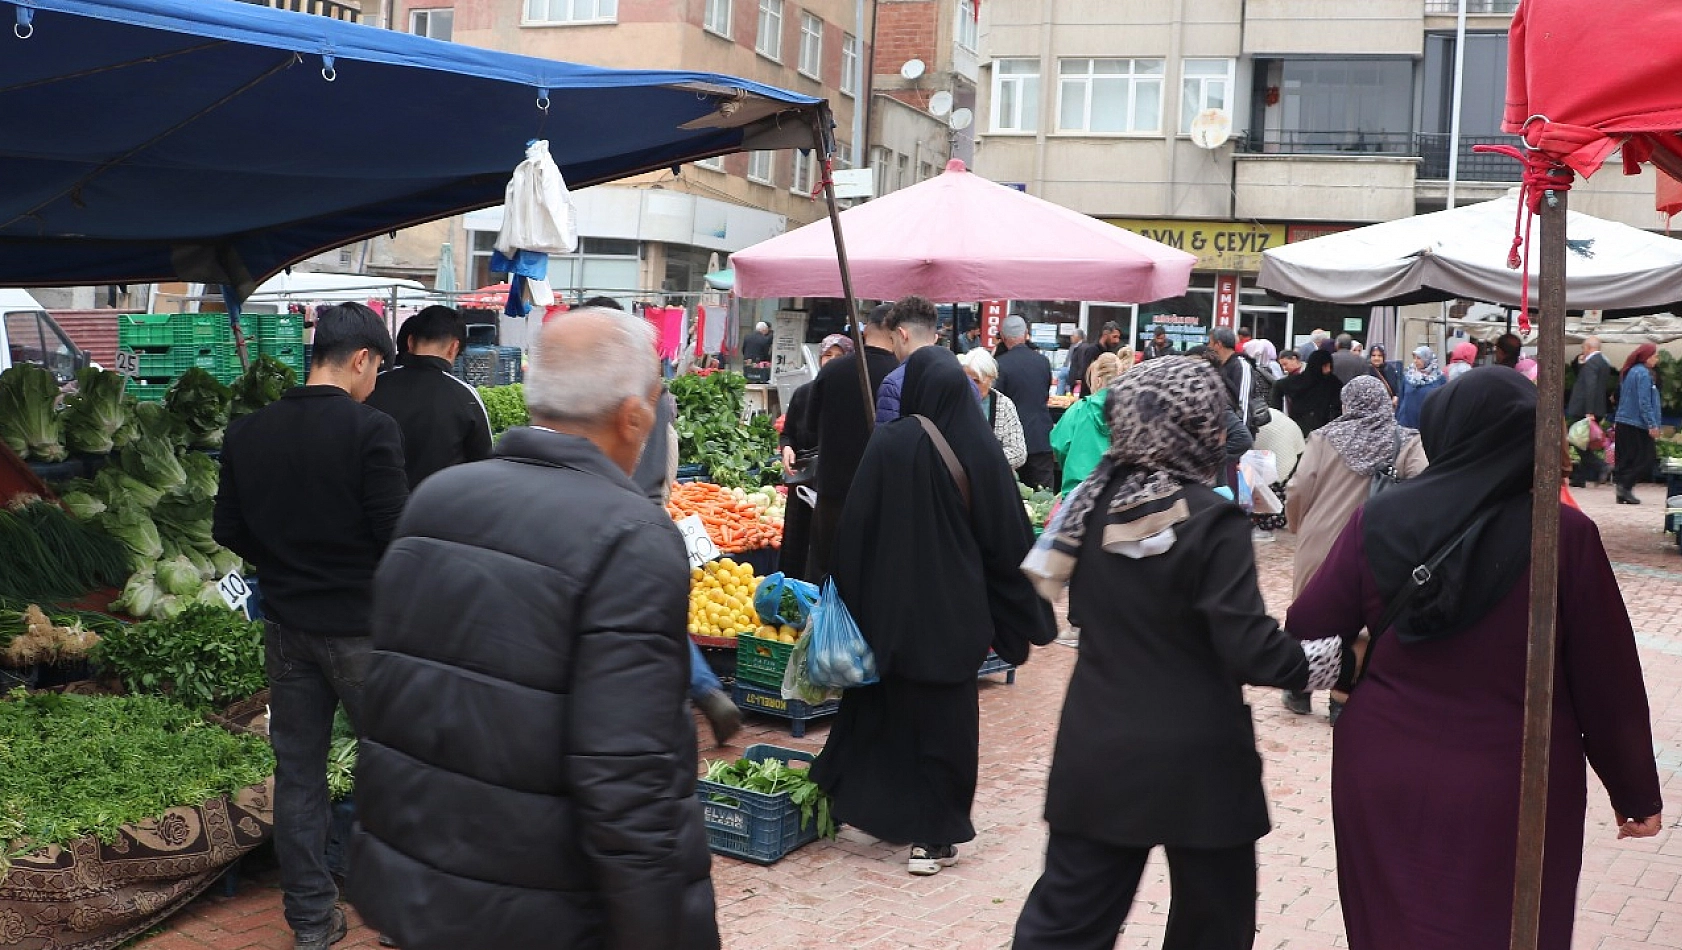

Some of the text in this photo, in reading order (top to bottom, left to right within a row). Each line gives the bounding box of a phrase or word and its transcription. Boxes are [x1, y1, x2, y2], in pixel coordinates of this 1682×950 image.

[1191, 231, 1207, 250] &
[1214, 225, 1272, 256] ÇEYİZ
[118, 353, 137, 371] 25
[221, 573, 246, 604] 10
